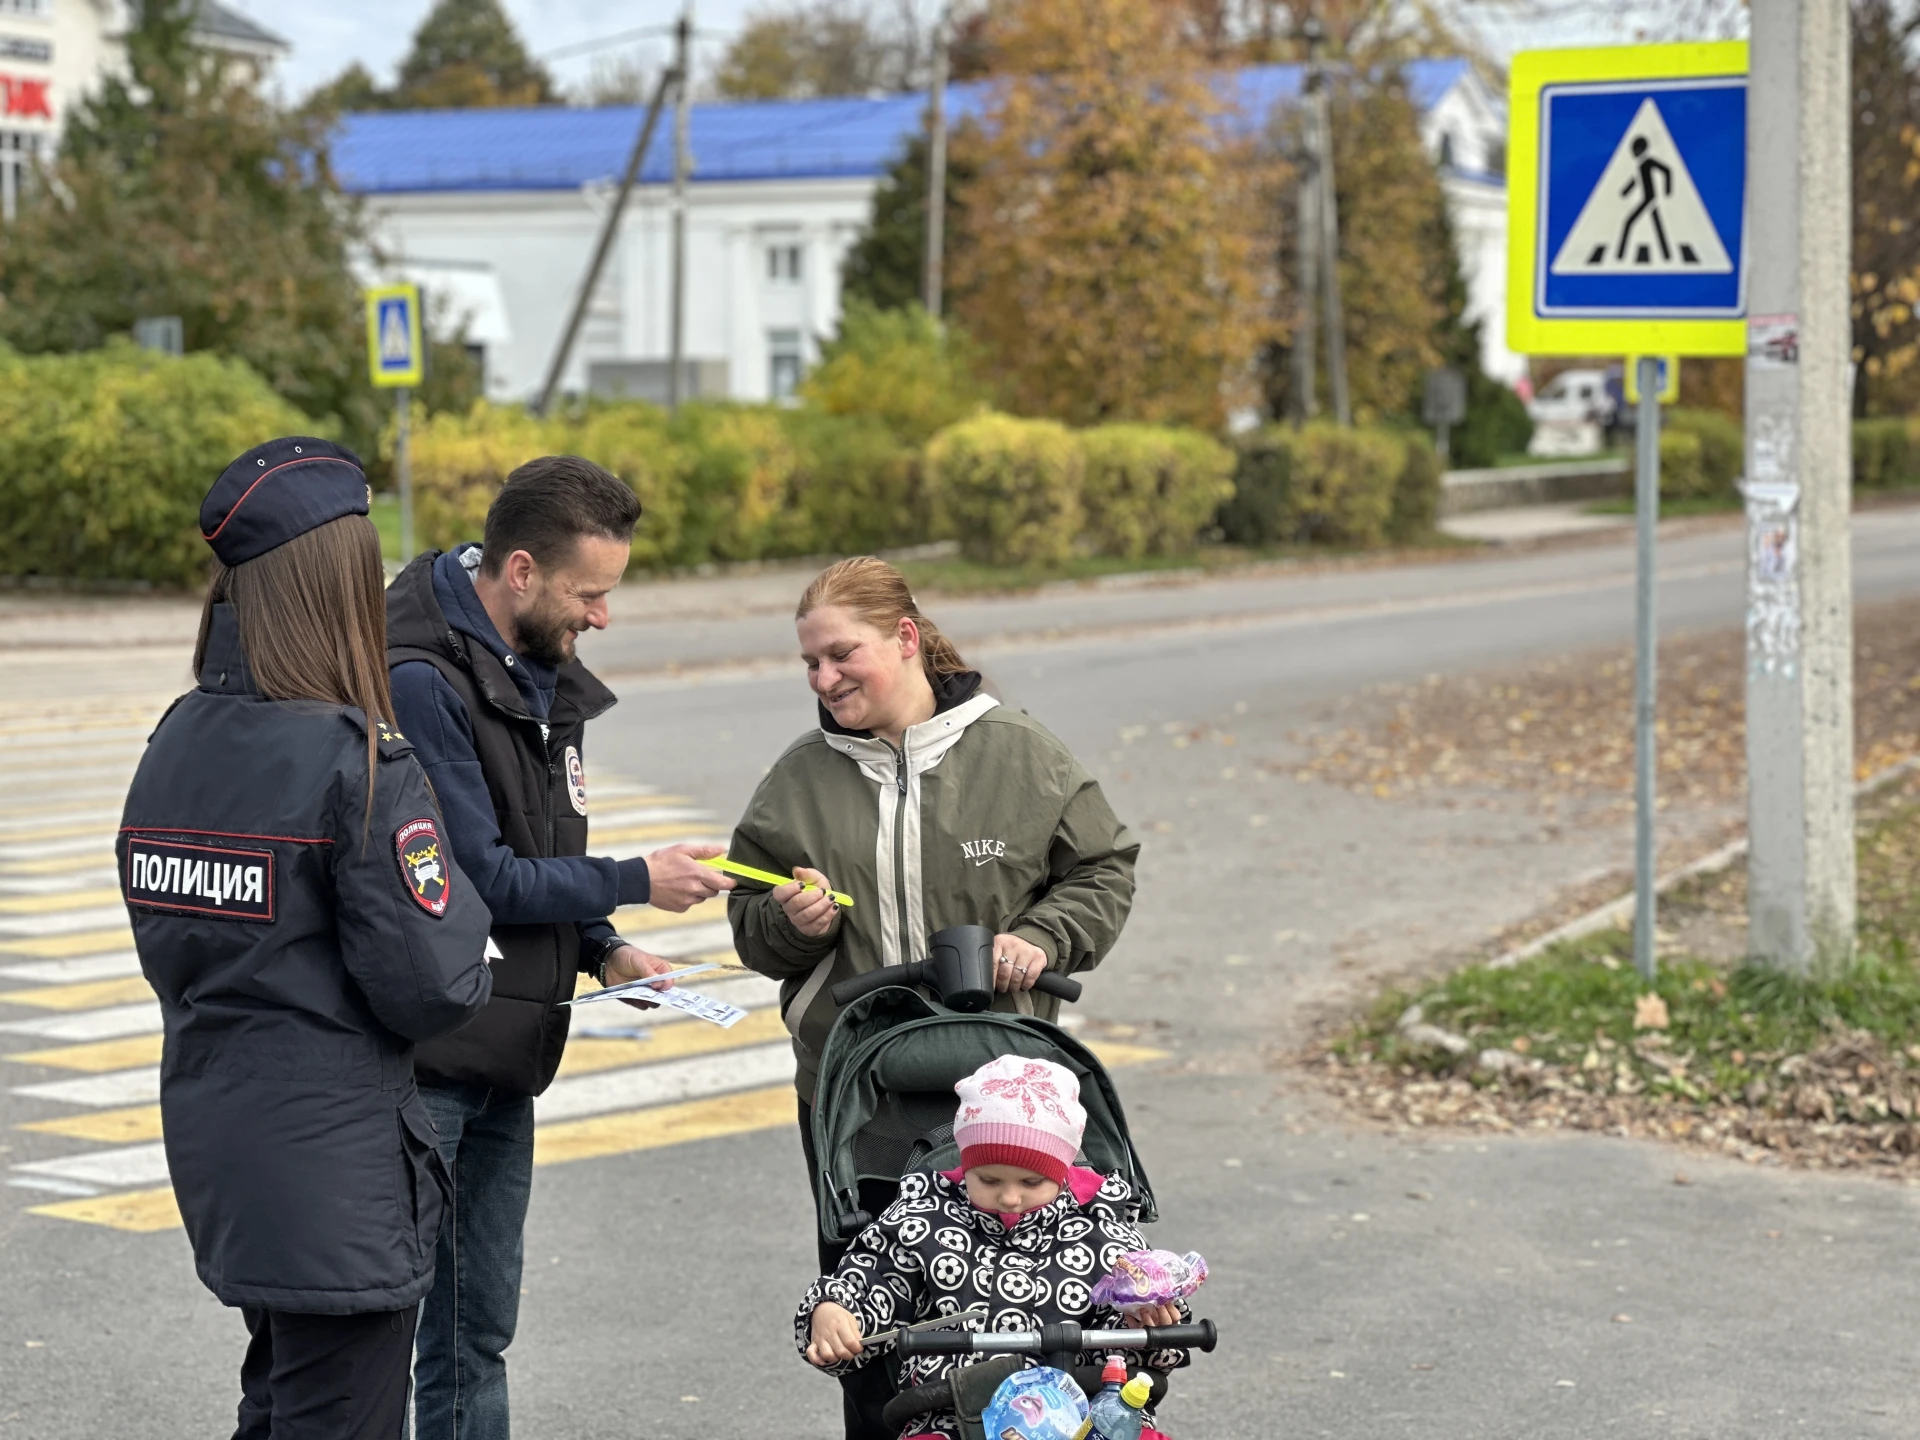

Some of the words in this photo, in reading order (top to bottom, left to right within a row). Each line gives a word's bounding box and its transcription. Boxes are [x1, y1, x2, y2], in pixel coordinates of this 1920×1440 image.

[399, 822, 433, 842] ПОЛИЦИЯ
[960, 839, 1006, 859] NIKE
[132, 852, 263, 906] ПОЛИЦИЯ
